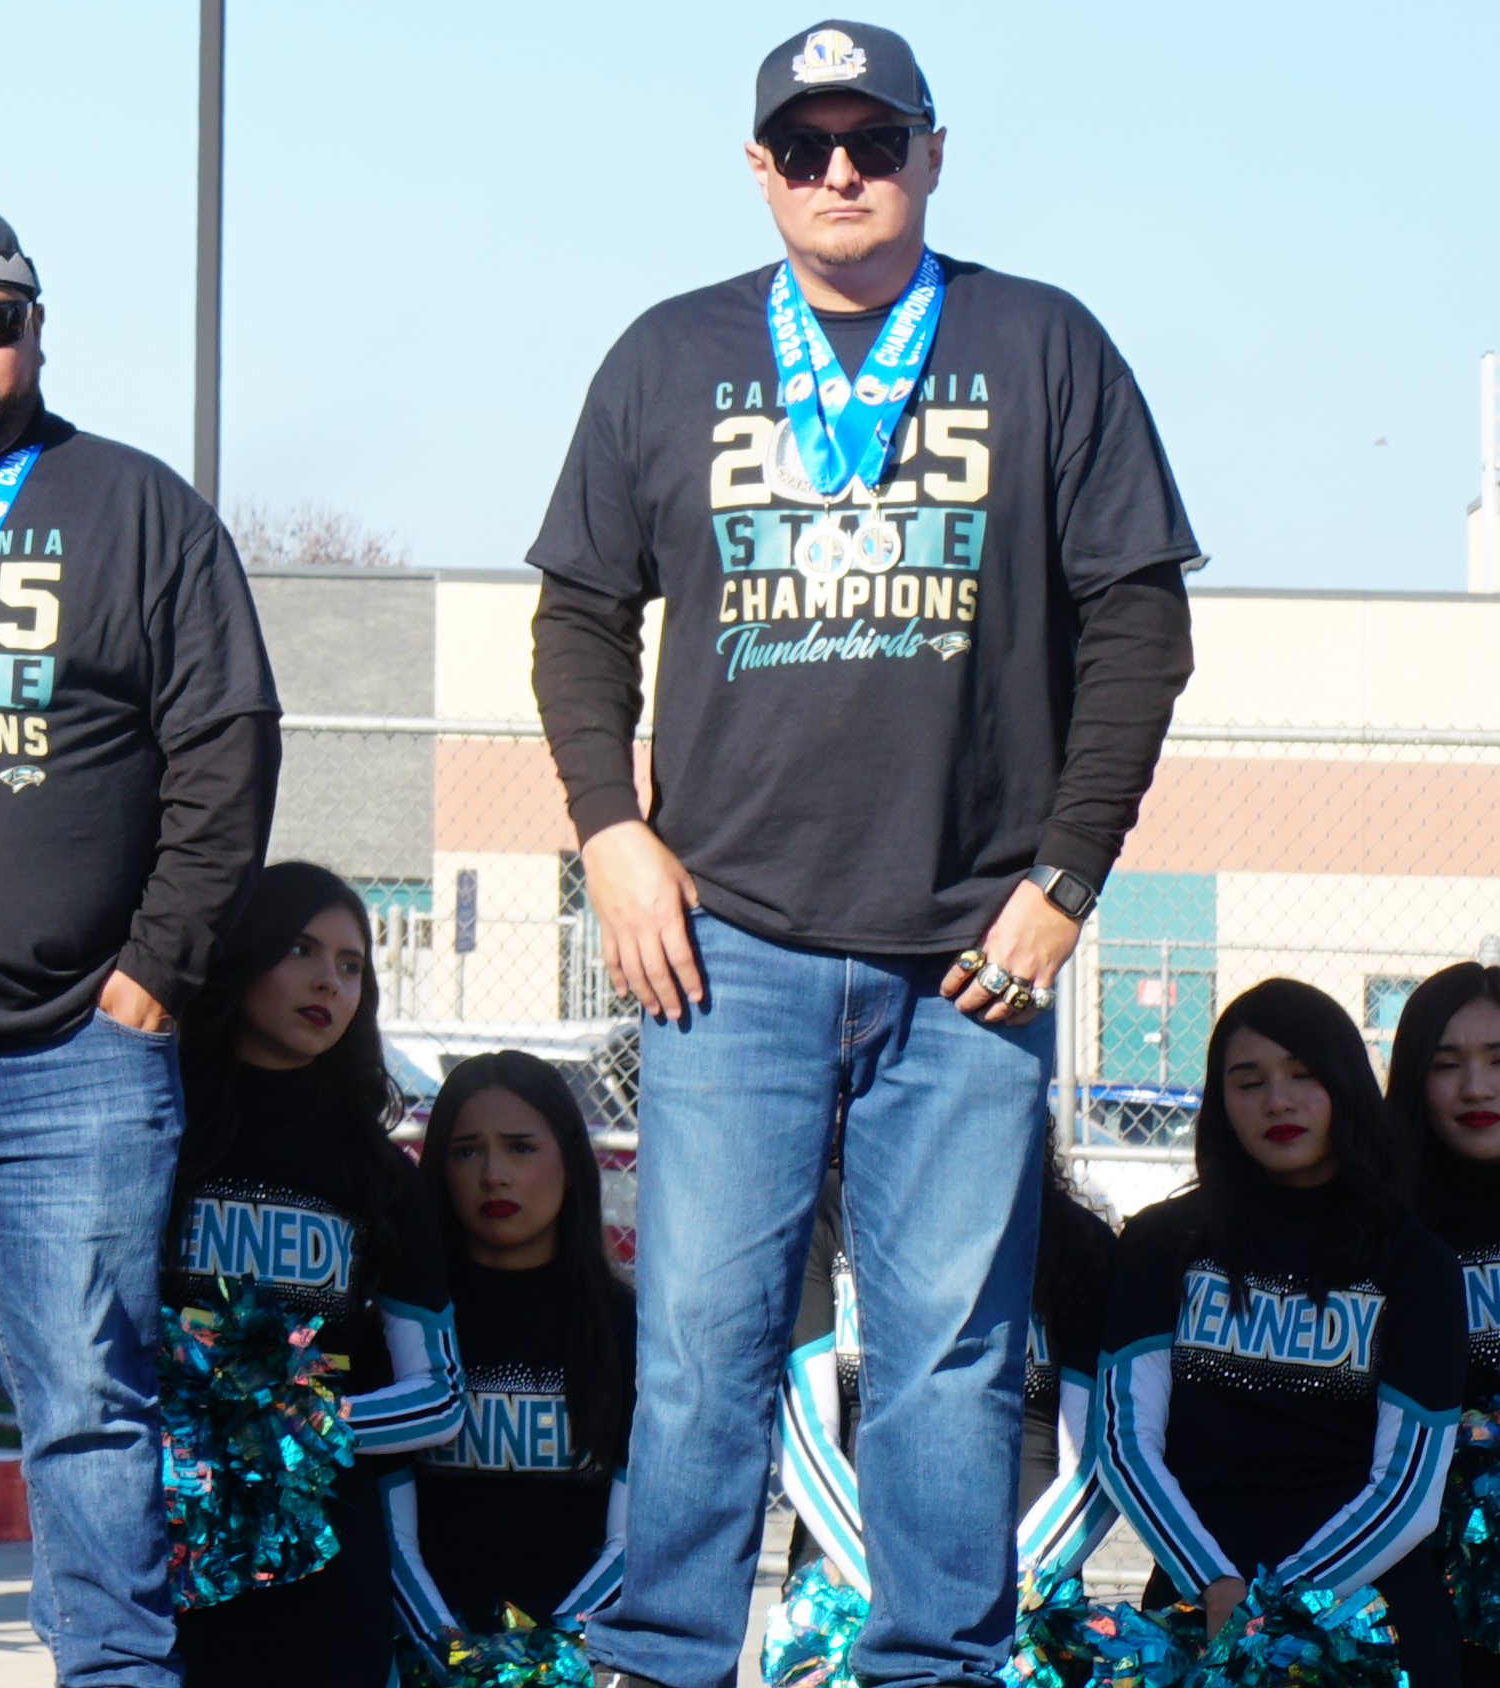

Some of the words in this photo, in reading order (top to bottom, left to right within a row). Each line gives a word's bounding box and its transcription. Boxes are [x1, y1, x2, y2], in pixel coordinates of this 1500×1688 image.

[874, 253, 940, 368] CHAMPIONSHIPS
[715, 372, 989, 411] CALNIA
[719, 574, 980, 624] CHAMPIONS
[715, 615, 928, 683] Thunderbirds
[1174, 1268, 1388, 1374] KENNEDY
